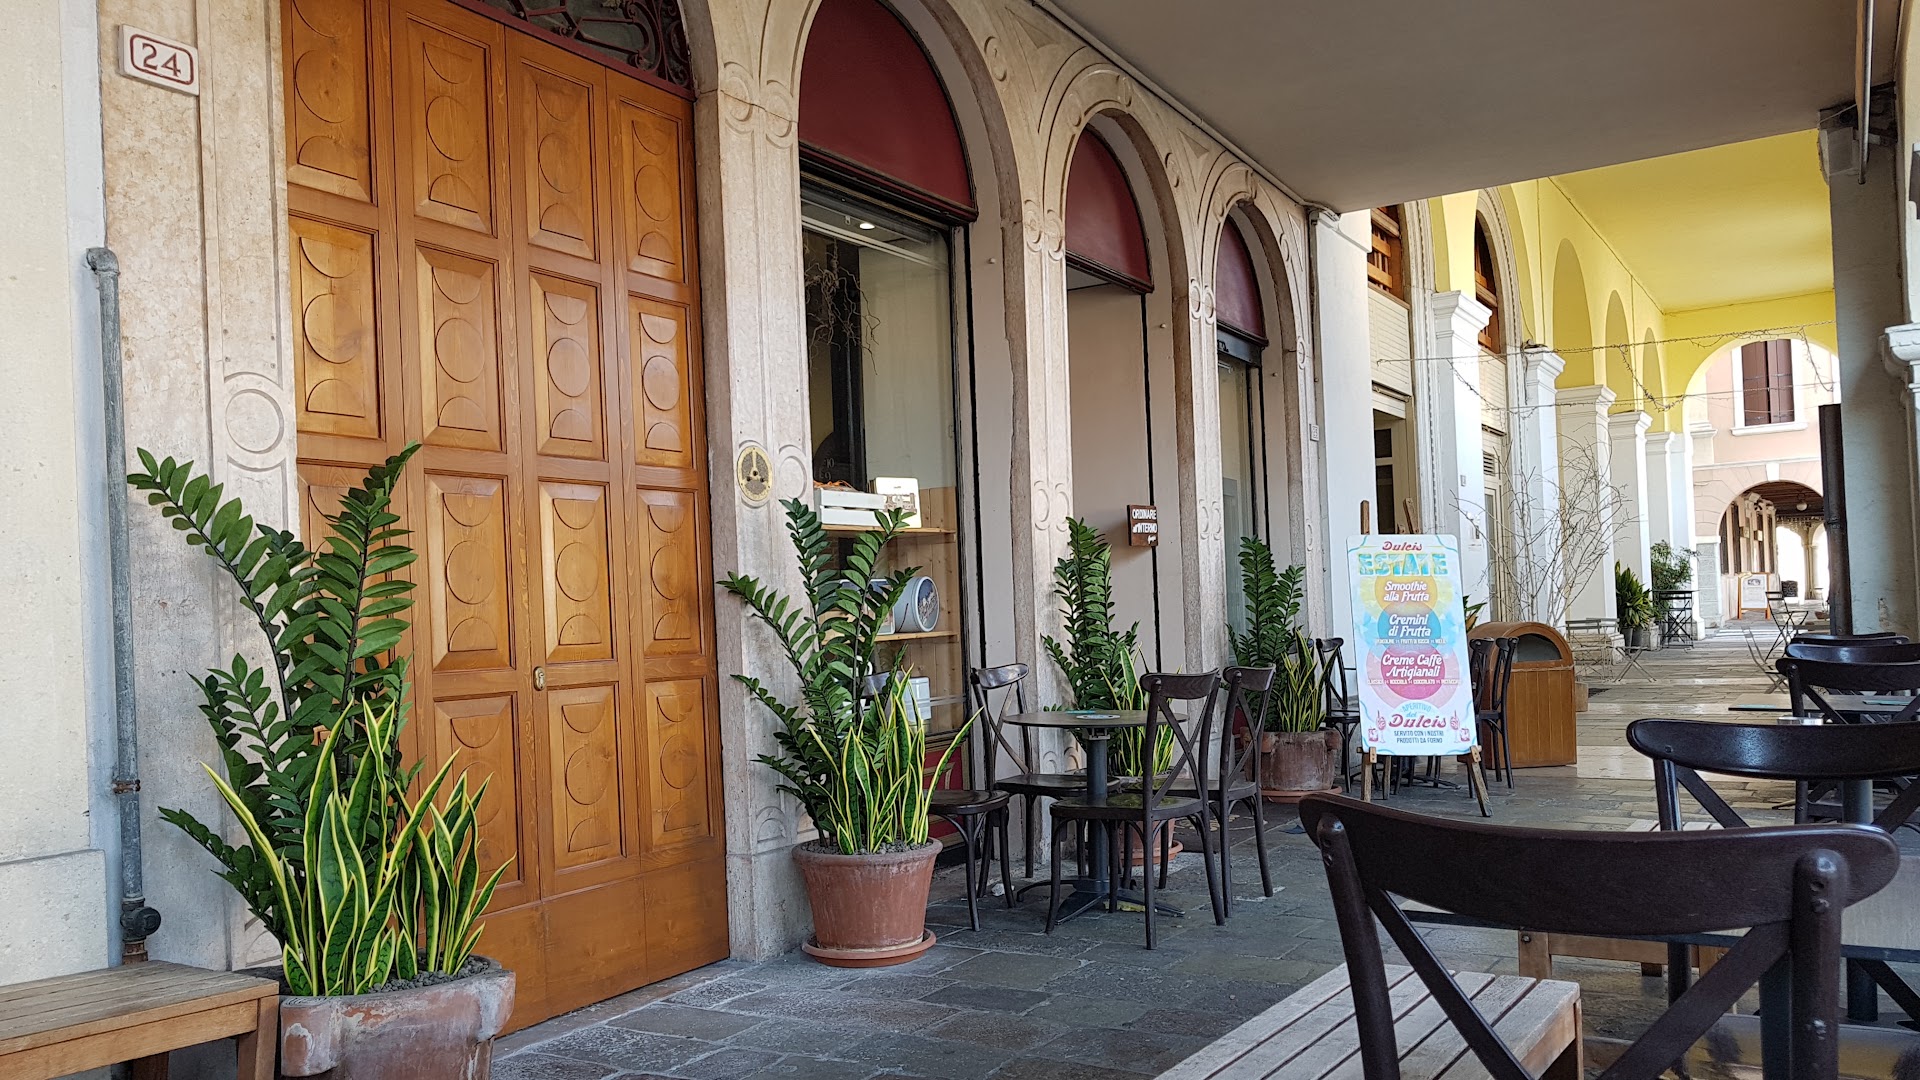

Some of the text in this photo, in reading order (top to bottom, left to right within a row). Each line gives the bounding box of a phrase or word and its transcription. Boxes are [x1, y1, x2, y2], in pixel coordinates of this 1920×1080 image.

[141, 42, 182, 77] 24
[1132, 509, 1157, 520] ORDINARE
[1382, 541, 1423, 551] Dulcis
[1358, 553, 1448, 575] ESTATE
[1384, 581, 1427, 591] Smoothie
[1384, 591, 1429, 602] alla Frutta
[1390, 614, 1428, 625] Cremini
[1389, 625, 1431, 637] di Frutta
[1382, 654, 1414, 665] Creme
[1386, 666, 1440, 680] Artigianali
[1402, 702, 1432, 712] APERITIVO
[1389, 714, 1446, 727] Dulcis
